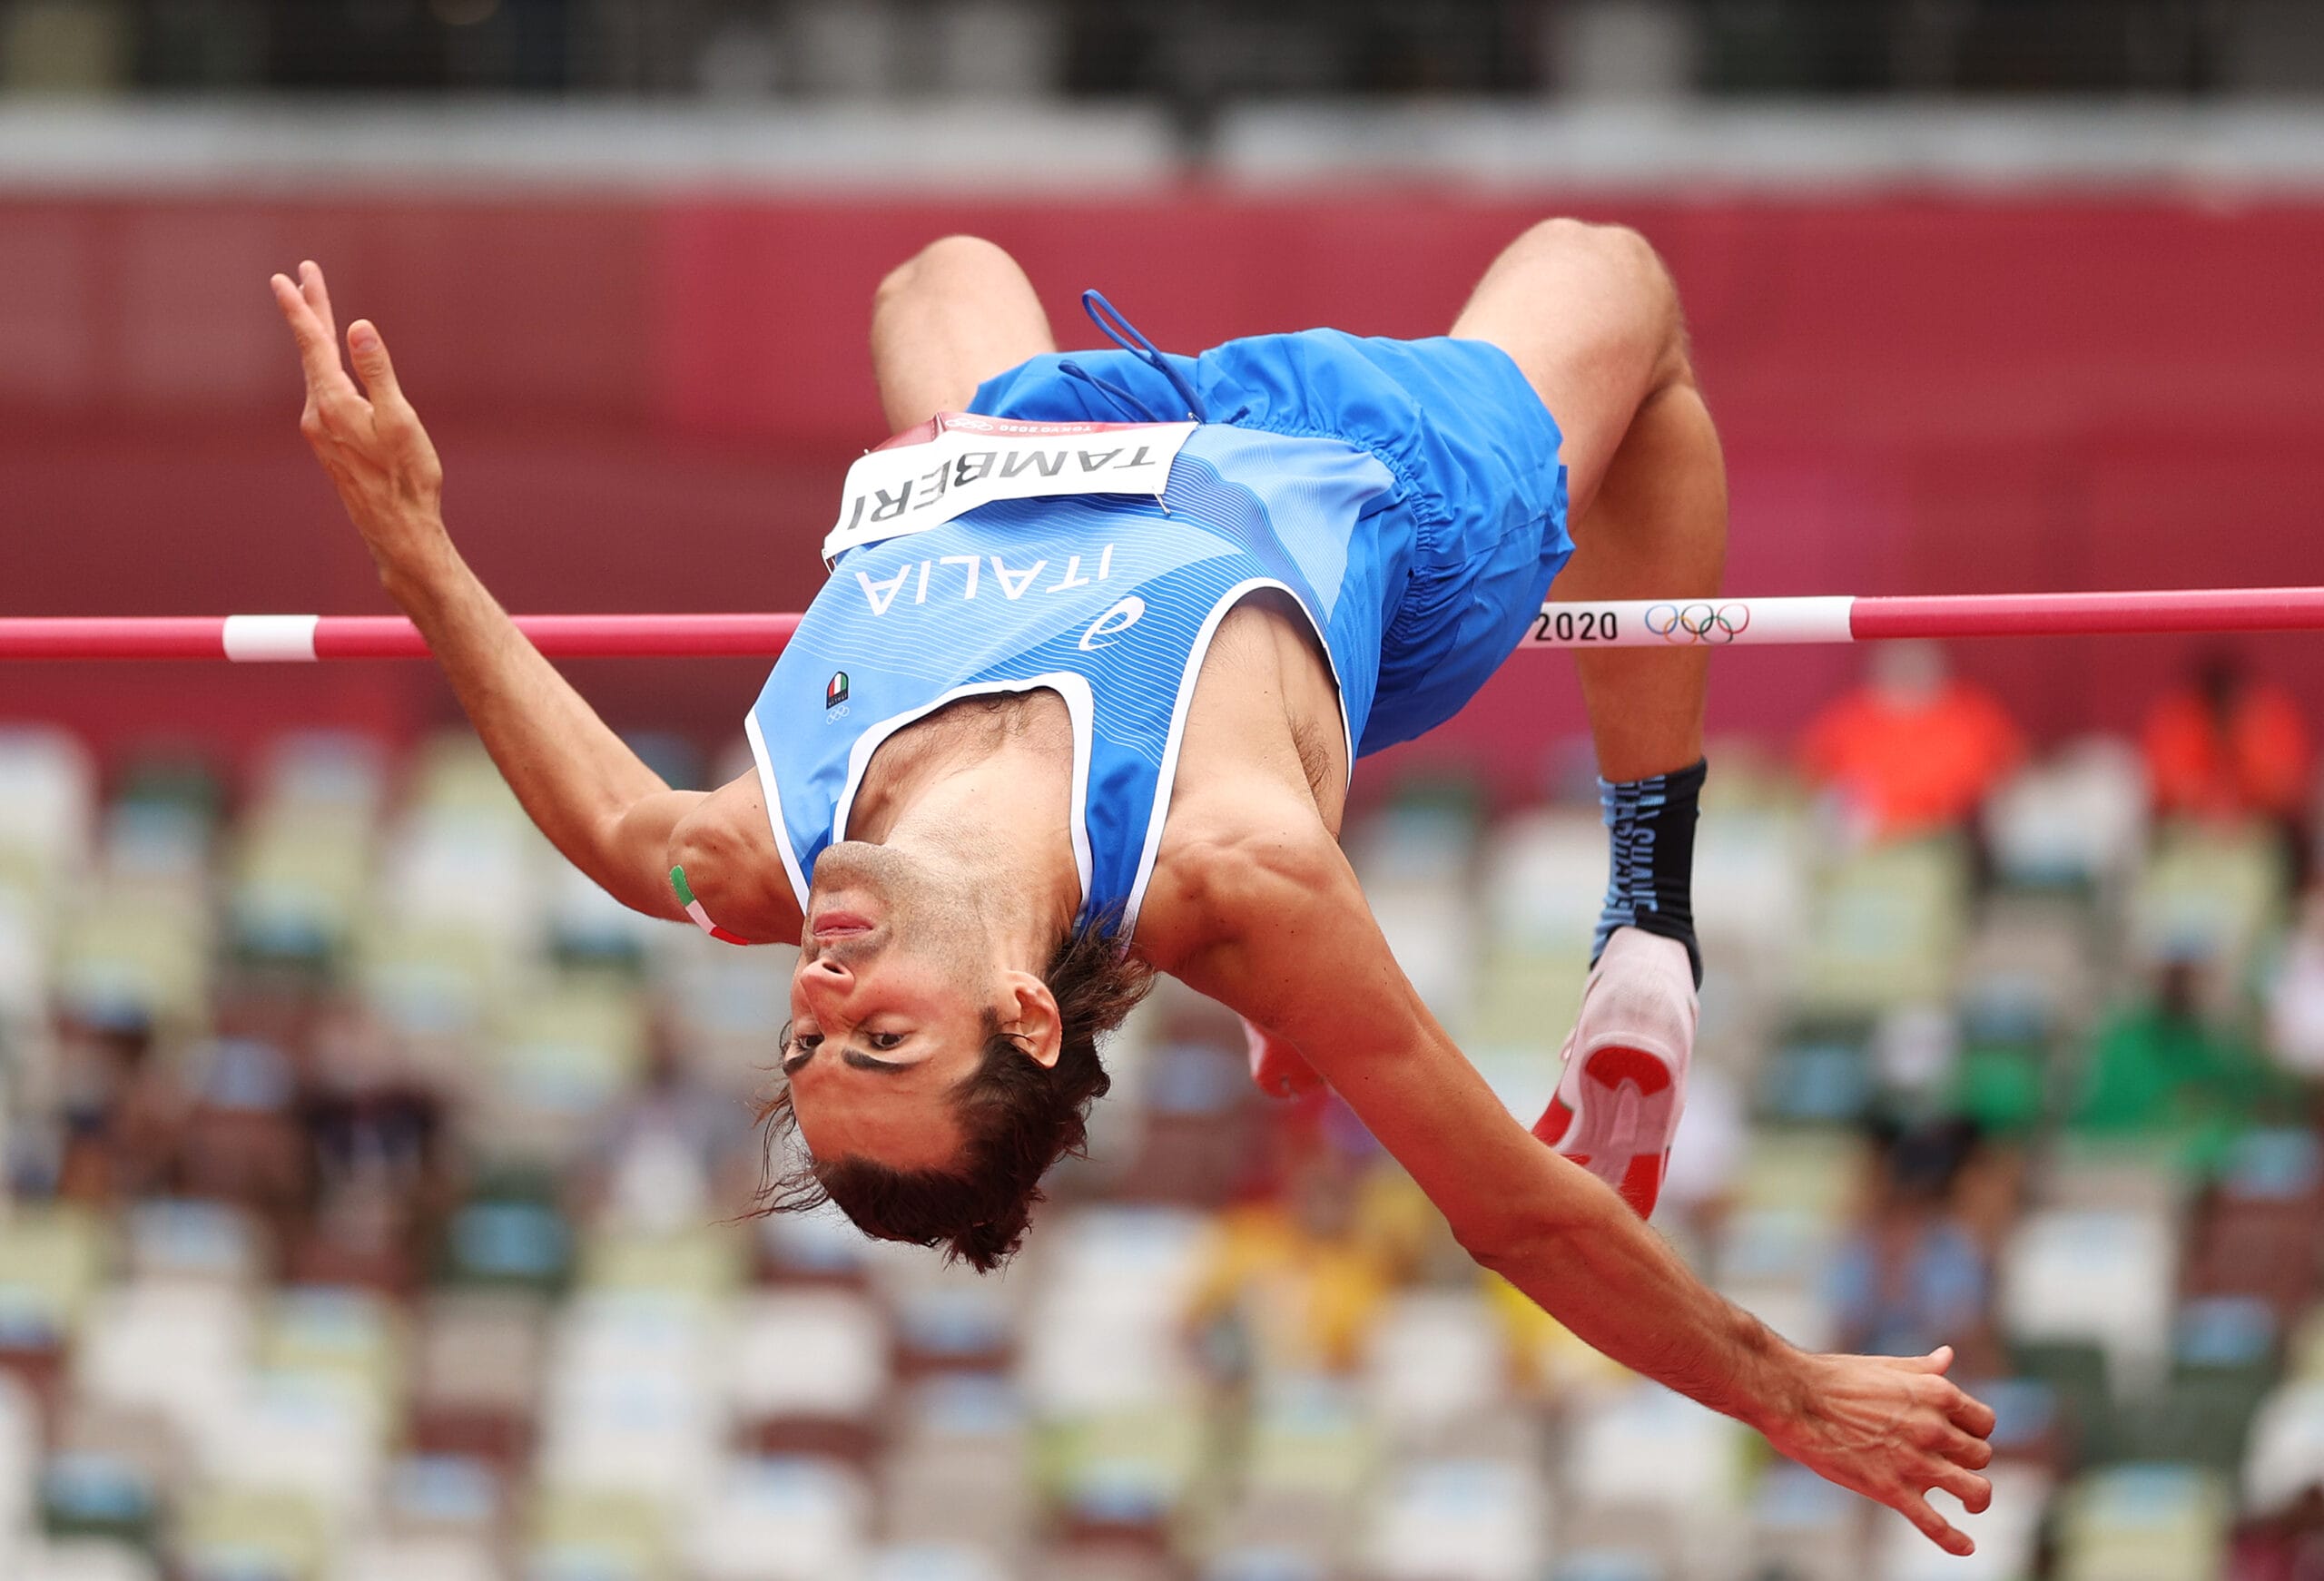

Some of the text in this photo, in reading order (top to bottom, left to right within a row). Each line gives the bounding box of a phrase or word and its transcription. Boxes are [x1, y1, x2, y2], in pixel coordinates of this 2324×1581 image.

[1000, 425, 1039, 433] 2020
[847, 446, 1157, 530] TAMBERI
[854, 543, 1116, 617] ITALIA
[1534, 611, 1619, 642] 2020
